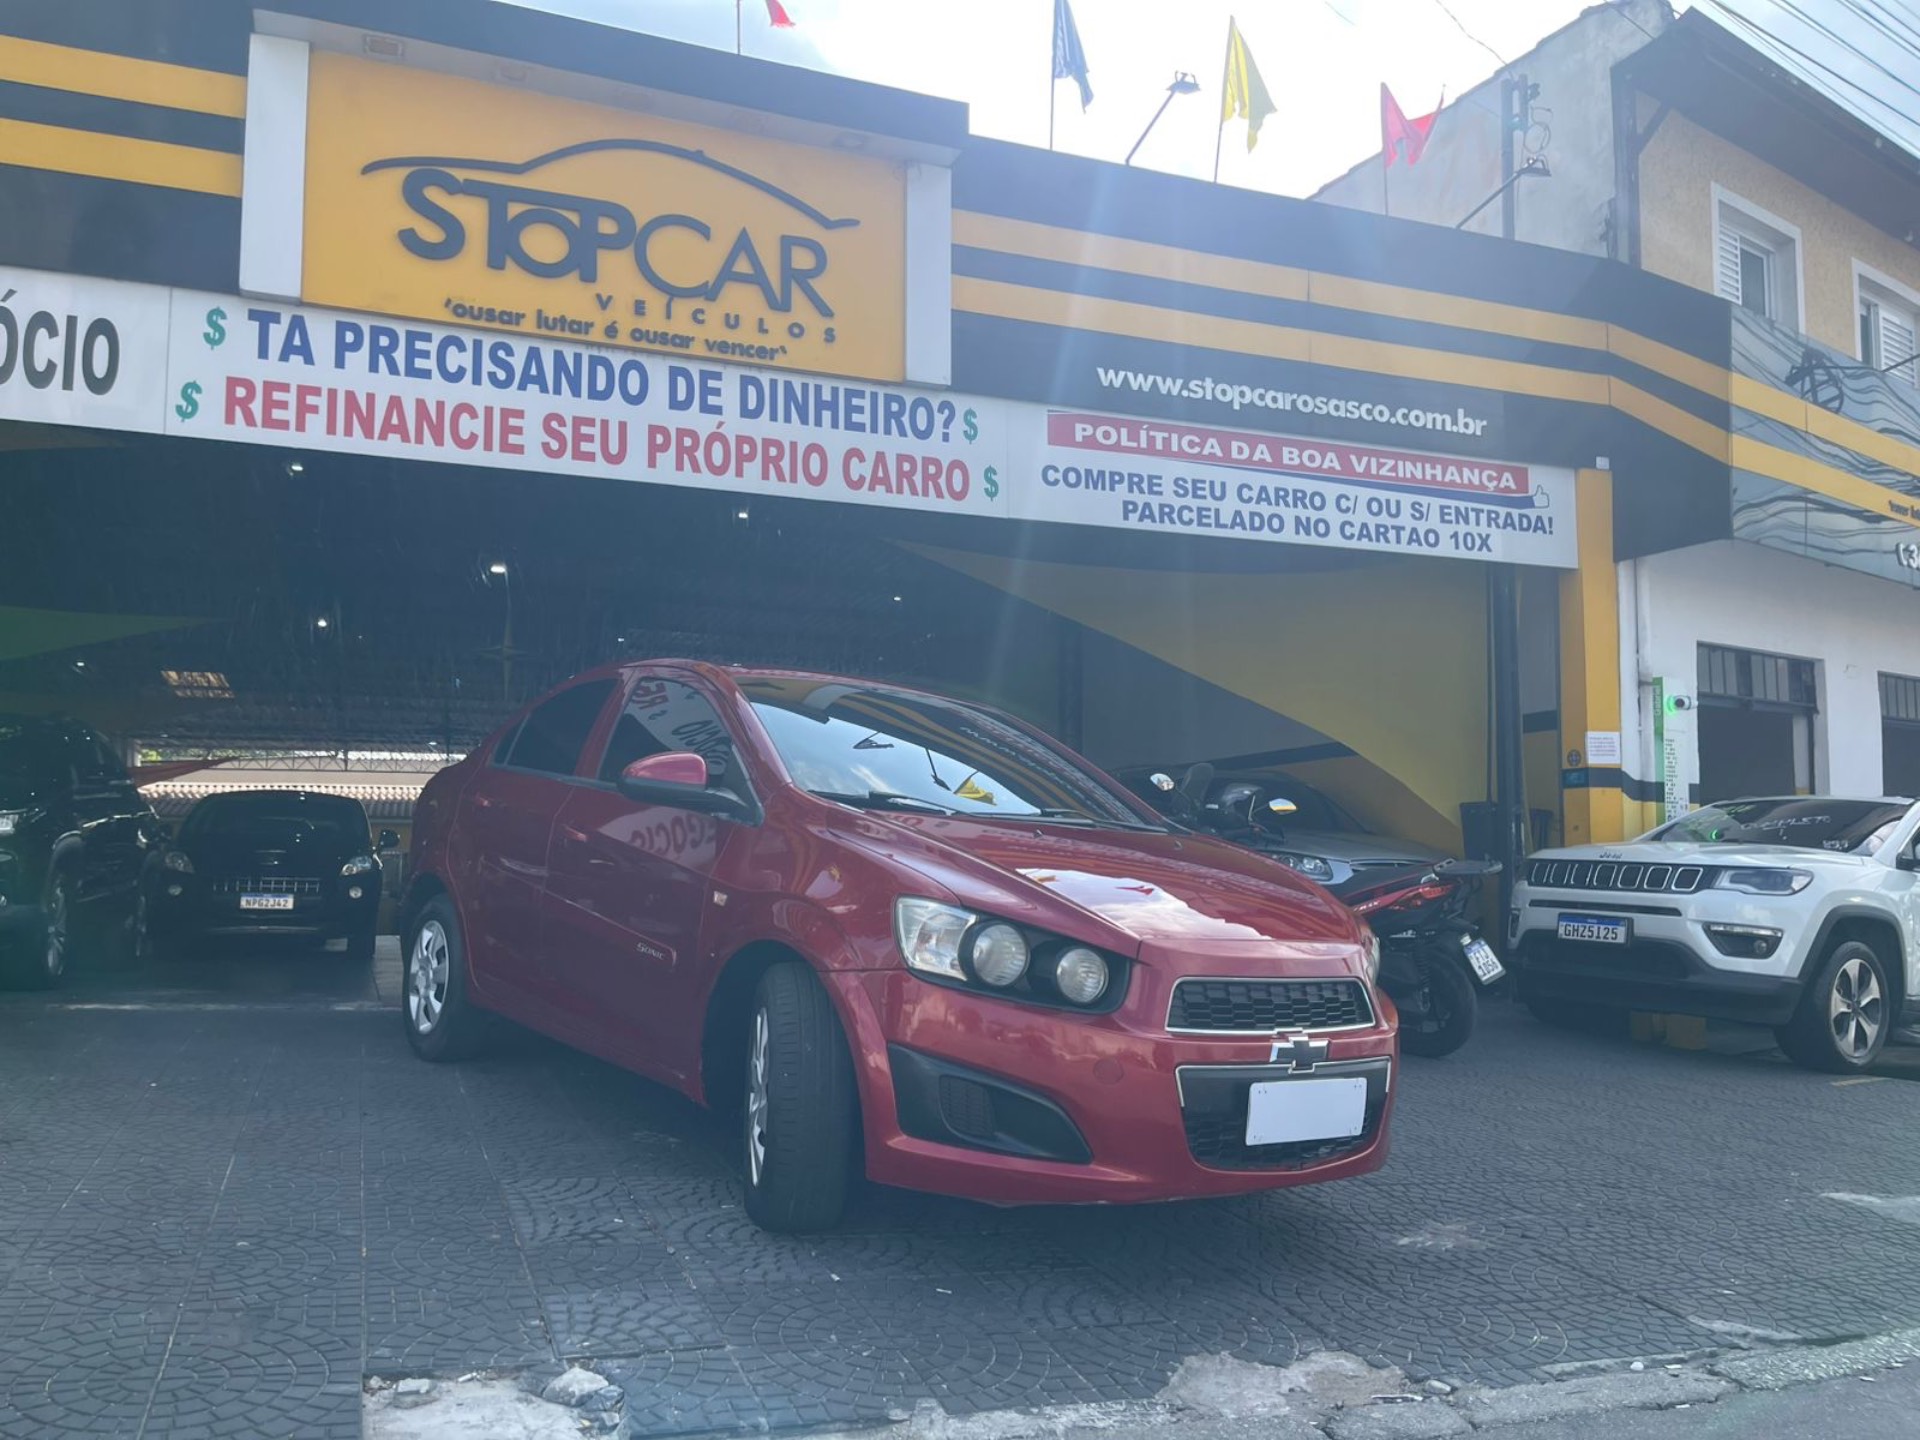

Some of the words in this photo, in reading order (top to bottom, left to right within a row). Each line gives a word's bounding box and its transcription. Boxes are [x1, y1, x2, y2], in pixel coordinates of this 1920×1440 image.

[397, 167, 835, 318] STOPCAR
[535, 308, 595, 336] lutar
[603, 319, 619, 340] é
[629, 326, 696, 350] ousar
[595, 293, 837, 343] VEÍCULOS
[247, 308, 316, 367] TA
[334, 319, 650, 407] PRECISANDO
[668, 365, 724, 416] DE
[739, 374, 956, 443] DINHEIRO?
[1095, 366, 1488, 437] www.stopcarosasco.com.br
[223, 375, 526, 456] REFINANCIE
[540, 411, 628, 466] SEU
[647, 420, 829, 488] PRÓPRIO
[842, 447, 970, 502] CARRO
[1073, 422, 1224, 458] POLÍTICA
[1229, 440, 1273, 464] DA
[1281, 446, 1342, 471] BOA
[1349, 453, 1517, 492] VIZINHANÇA
[1040, 464, 1164, 497] COMPRE
[1172, 476, 1227, 502] SEU
[1235, 482, 1327, 512] CARRO
[1334, 493, 1359, 515] C/
[1366, 496, 1401, 519] OU
[1409, 500, 1431, 523] S/
[1438, 503, 1554, 536] ENTRADA!
[1121, 500, 1286, 535] PARCELADO
[1293, 515, 1331, 539] NO
[1338, 520, 1441, 549] CARTAO
[1449, 531, 1493, 553] 10X
